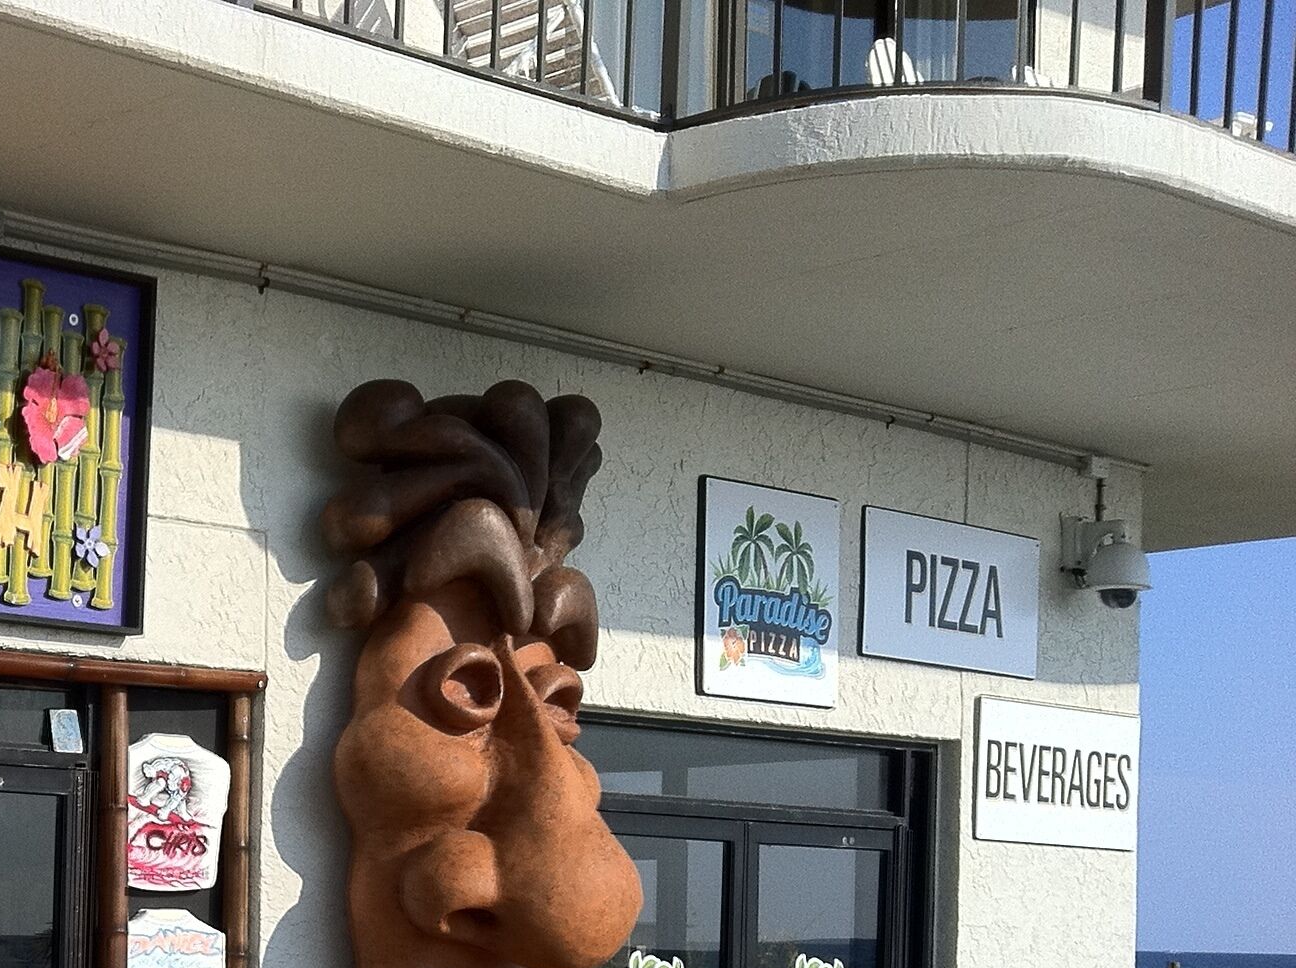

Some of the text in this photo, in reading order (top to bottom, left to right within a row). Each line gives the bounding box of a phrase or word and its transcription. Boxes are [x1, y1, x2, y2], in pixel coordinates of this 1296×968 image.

[717, 580, 829, 640] Paradise
[906, 550, 1004, 638] PIZZA
[748, 630, 799, 660] PIZZA
[986, 739, 1132, 811] BEVERAGES
